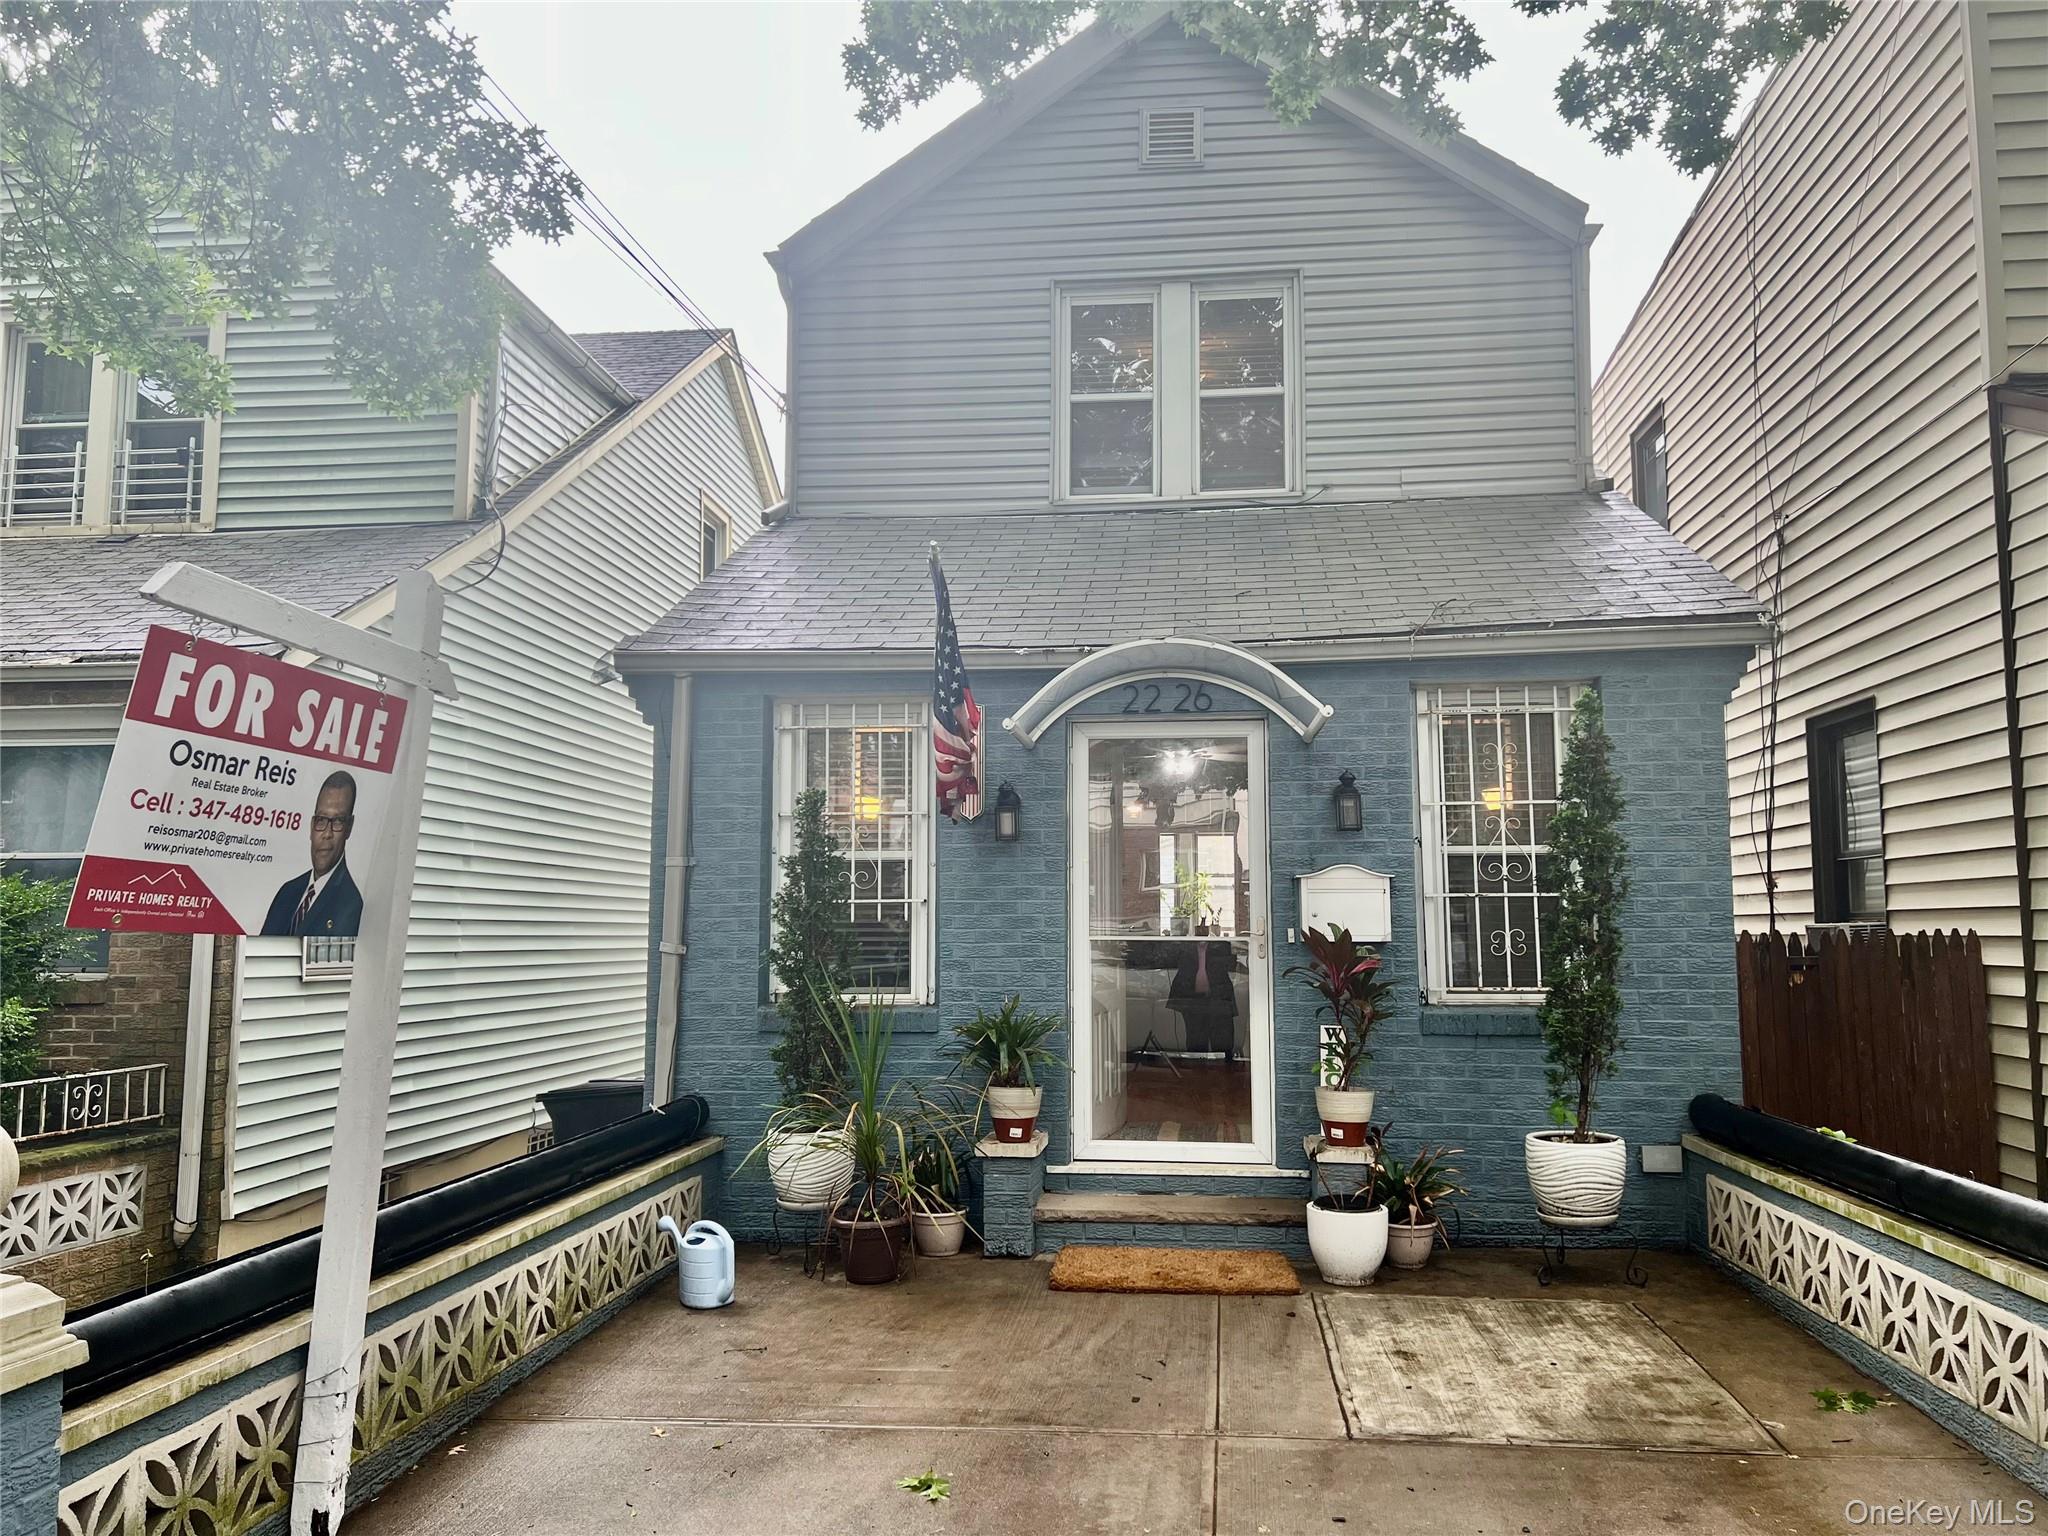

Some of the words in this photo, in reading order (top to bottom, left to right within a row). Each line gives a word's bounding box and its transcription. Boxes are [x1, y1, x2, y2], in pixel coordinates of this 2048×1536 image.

[154, 652, 275, 739] FOR
[288, 688, 389, 764] SALE
[1122, 684, 1161, 713] 22
[1173, 683, 1213, 711] 26
[169, 739, 250, 777] Osmar
[254, 755, 297, 786] Reis
[191, 776, 212, 790] Real
[213, 780, 240, 794] Estate
[241, 785, 269, 799] Broker
[130, 788, 174, 814] Cell
[188, 797, 302, 831] 347-489-1618
[147, 823, 267, 847] reisosmar208@gmail.com
[143, 840, 273, 863] www.privatehomesrealty.com
[86, 888, 136, 904] PRIVATE
[138, 892, 174, 907] HOMES
[176, 895, 213, 909] REALTY
[1324, 1027, 1344, 1087] WELC
